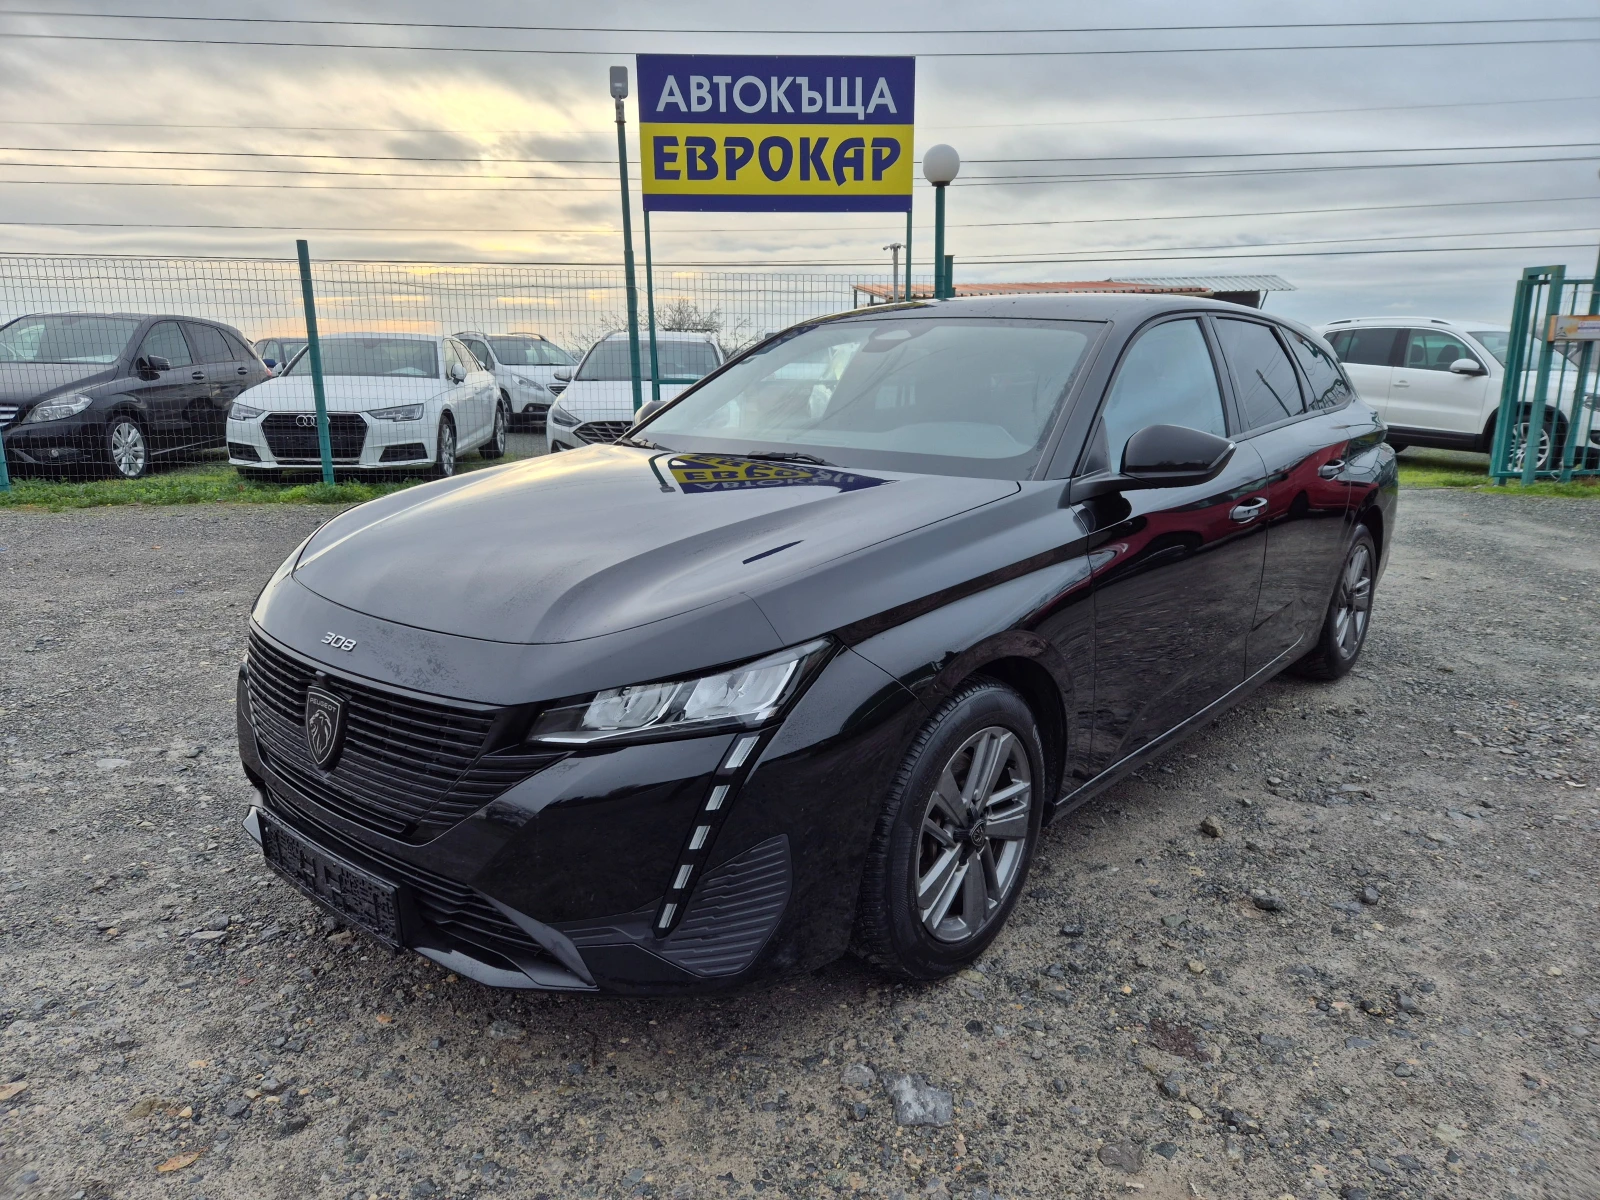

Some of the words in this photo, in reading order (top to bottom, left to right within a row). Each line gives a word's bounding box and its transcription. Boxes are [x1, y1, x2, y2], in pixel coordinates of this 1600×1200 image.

[656, 75, 897, 120] АВТОКЪЩА
[653, 136, 901, 186] ЕВРОКАР
[321, 631, 357, 652] 308
[309, 697, 336, 712] PEUGEOT
